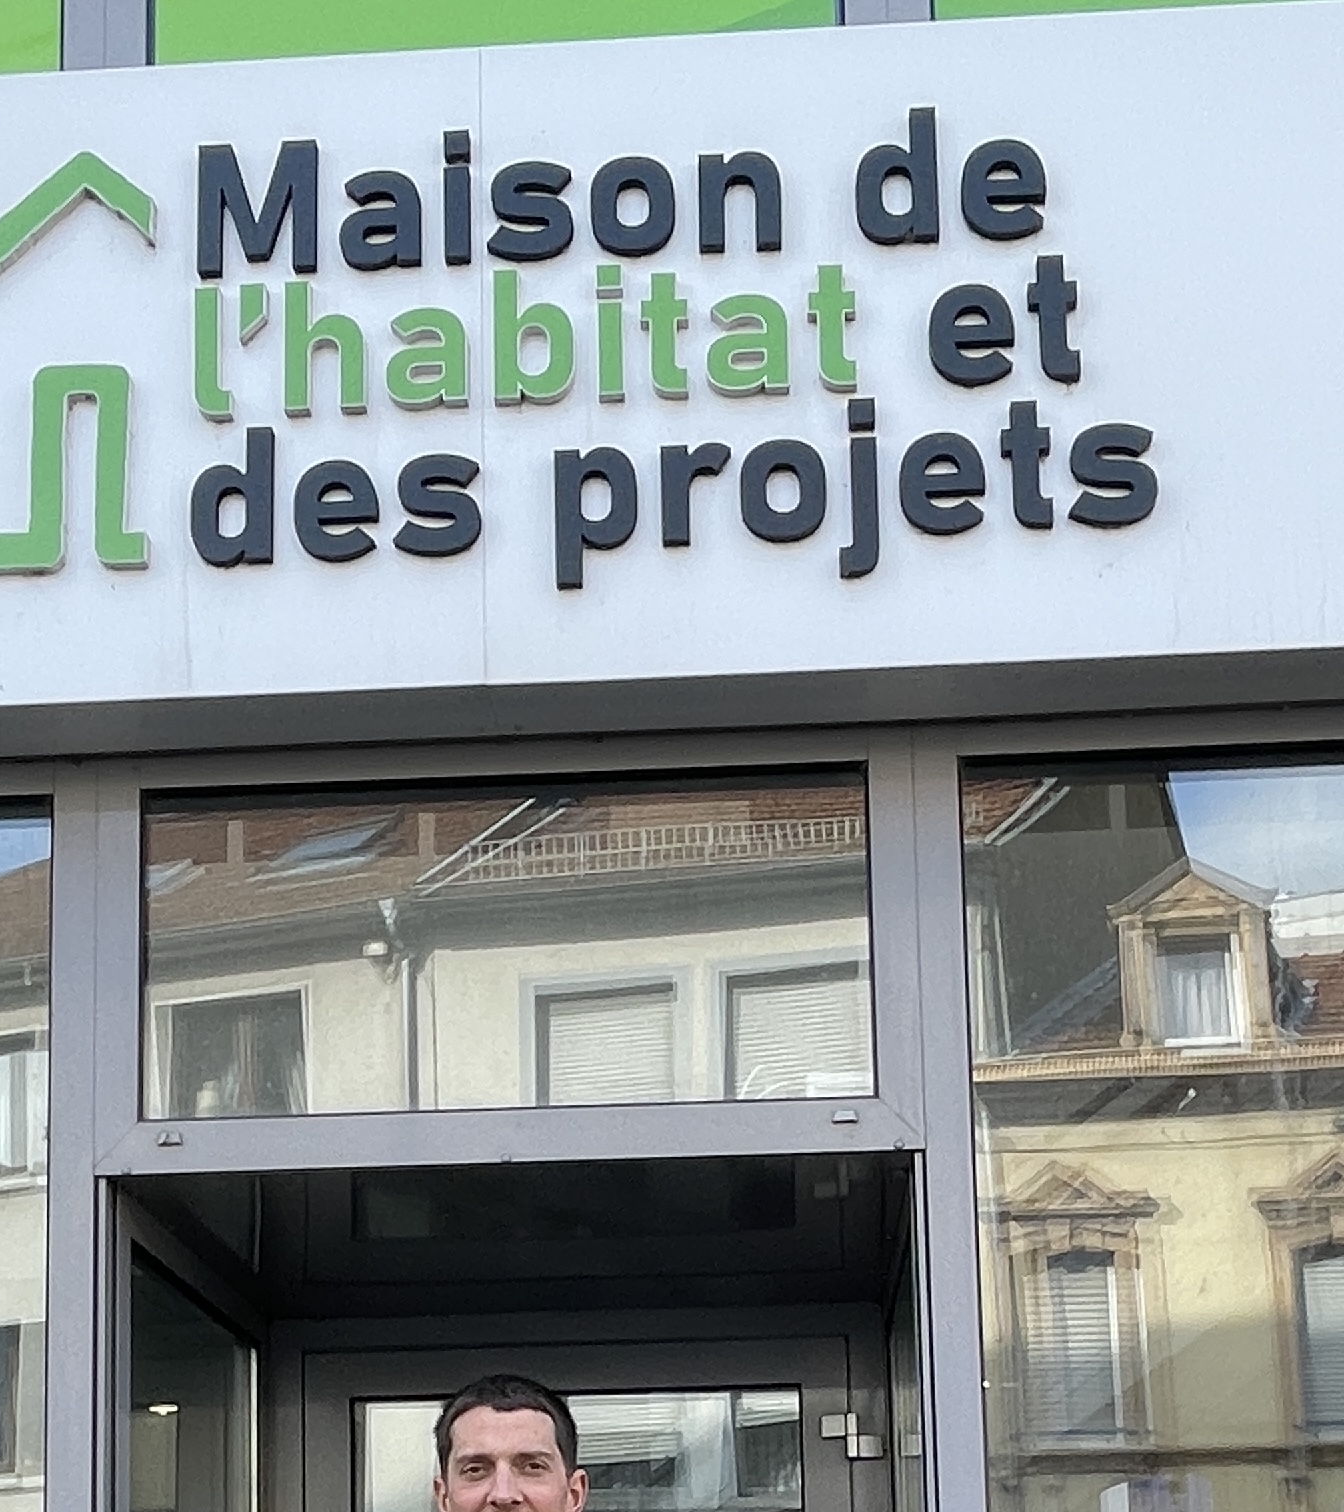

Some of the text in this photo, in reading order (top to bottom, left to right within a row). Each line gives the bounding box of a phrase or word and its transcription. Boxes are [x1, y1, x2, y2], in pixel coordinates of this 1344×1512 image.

[195, 105, 1048, 280] Maison de
[195, 253, 1082, 422] l'habitat et
[189, 397, 1160, 592] des projets
